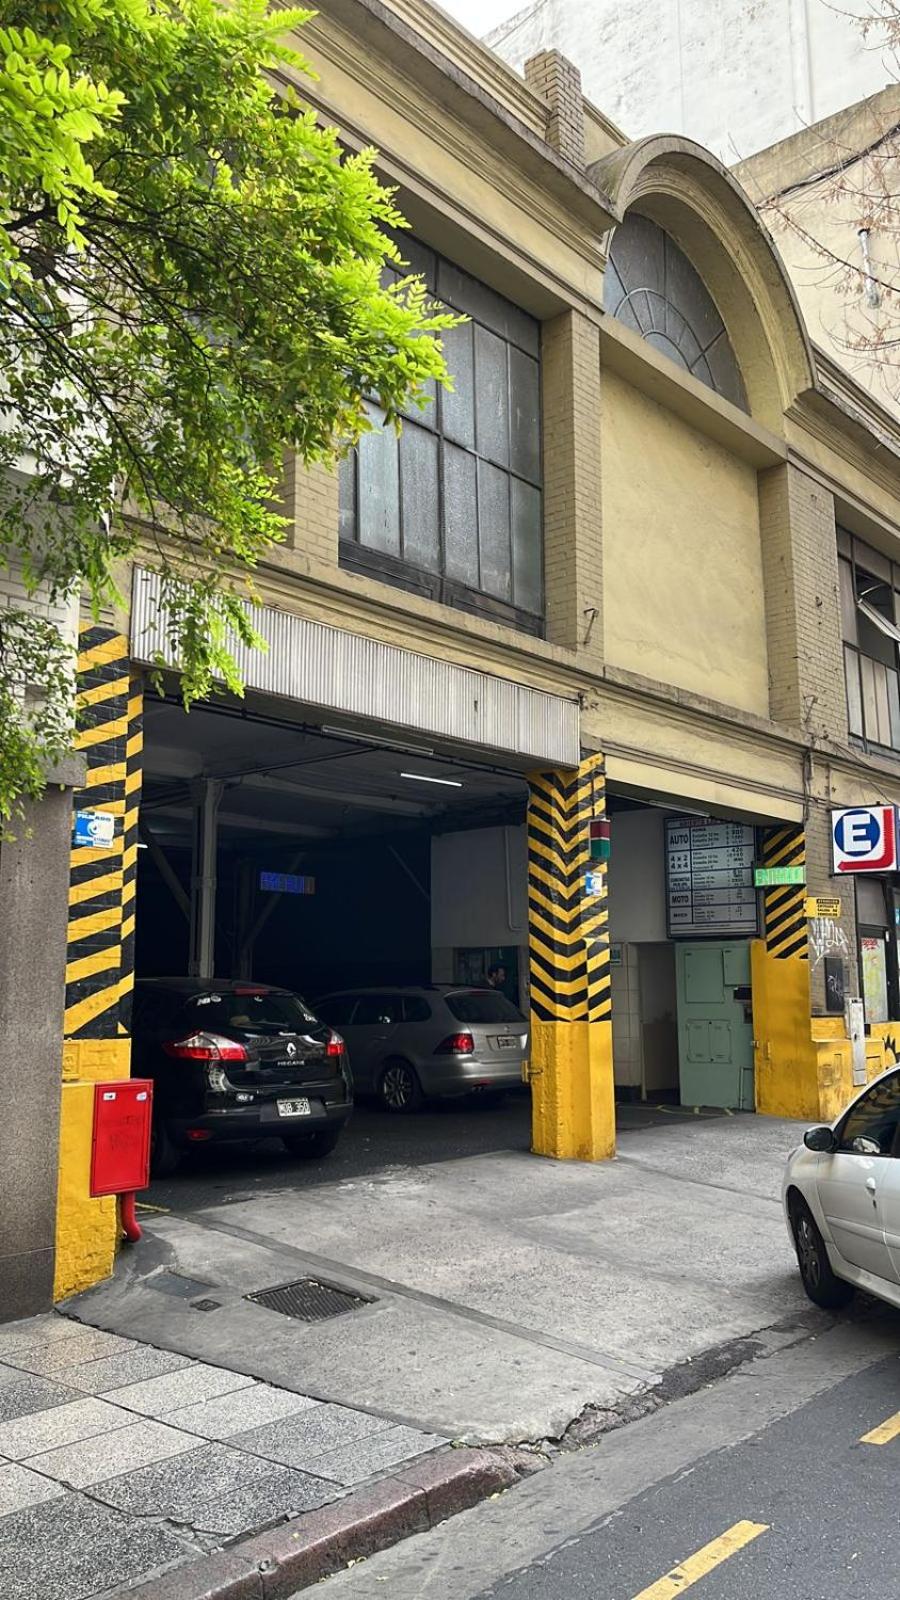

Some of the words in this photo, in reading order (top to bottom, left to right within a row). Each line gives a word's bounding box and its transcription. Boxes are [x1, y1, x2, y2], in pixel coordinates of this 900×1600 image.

[843, 813, 872, 852] E
[670, 834, 689, 845] AUTO
[671, 895, 689, 904] MOTO
